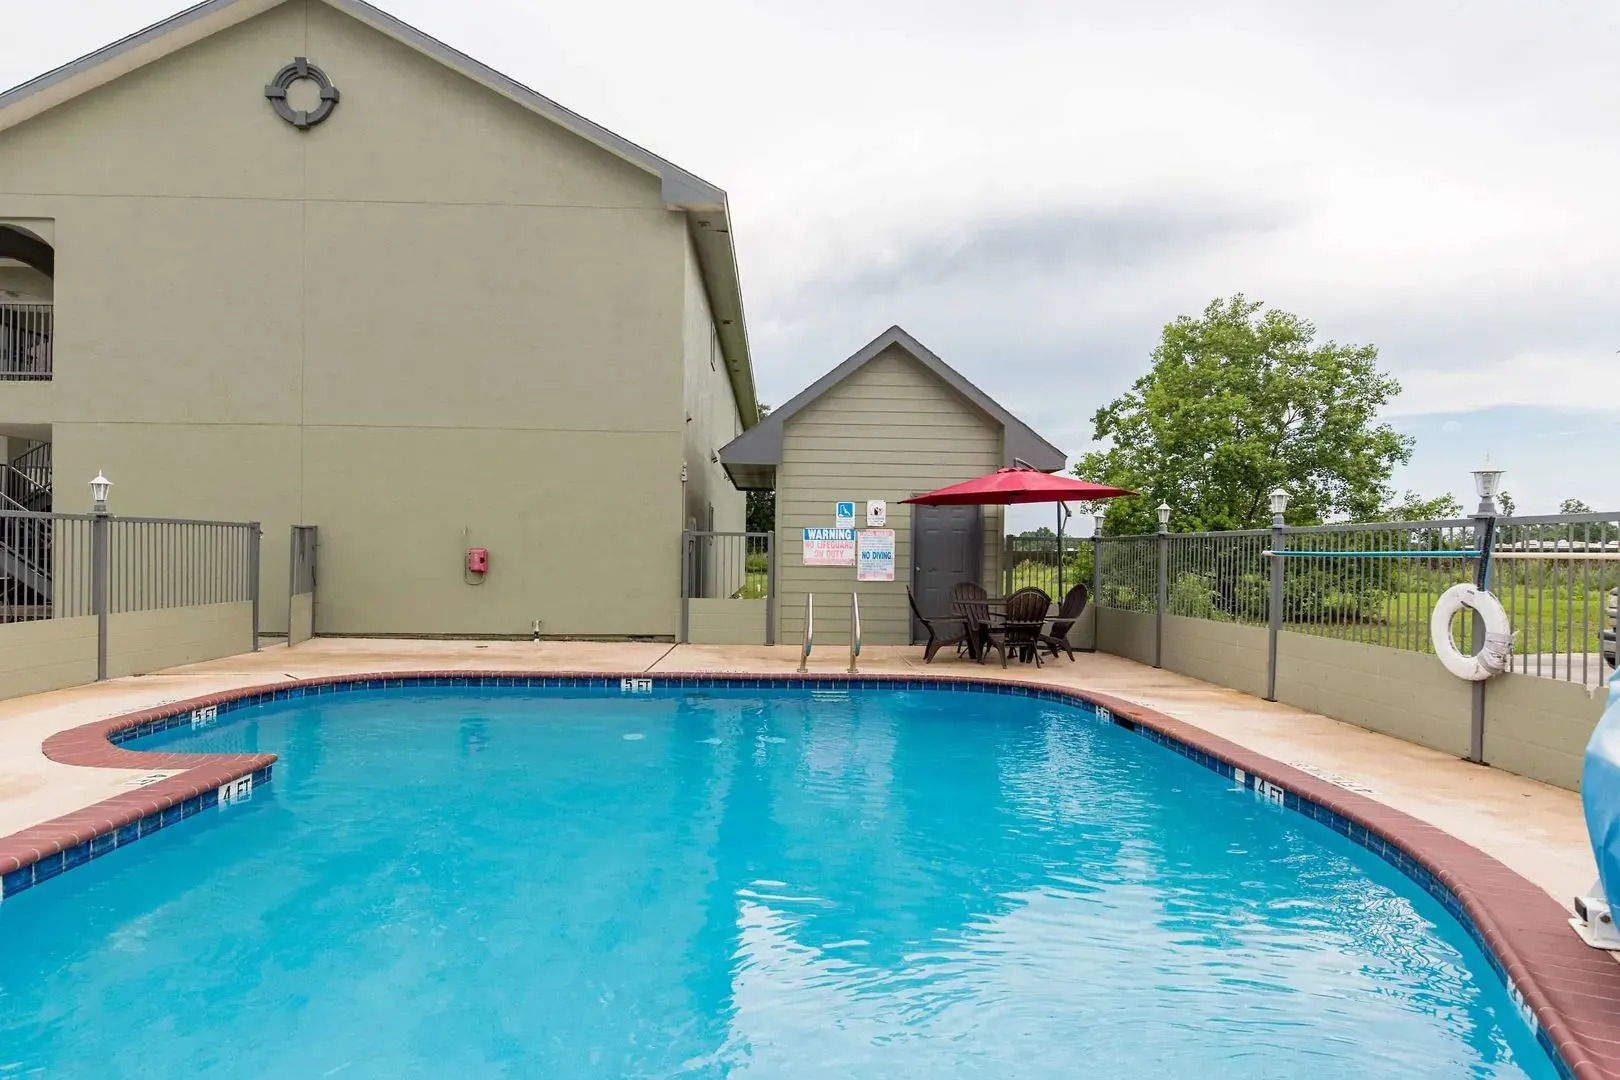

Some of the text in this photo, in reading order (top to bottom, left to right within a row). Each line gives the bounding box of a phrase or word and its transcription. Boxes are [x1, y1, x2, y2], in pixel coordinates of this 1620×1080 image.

[807, 529, 852, 540] WARNING
[817, 541, 854, 549] LIFEGUARD
[826, 550, 844, 558] DUTY
[861, 551, 892, 560] NO DIVING
[637, 680, 651, 691] FT
[237, 778, 251, 795] FT
[1258, 779, 1283, 802] 4 FT
